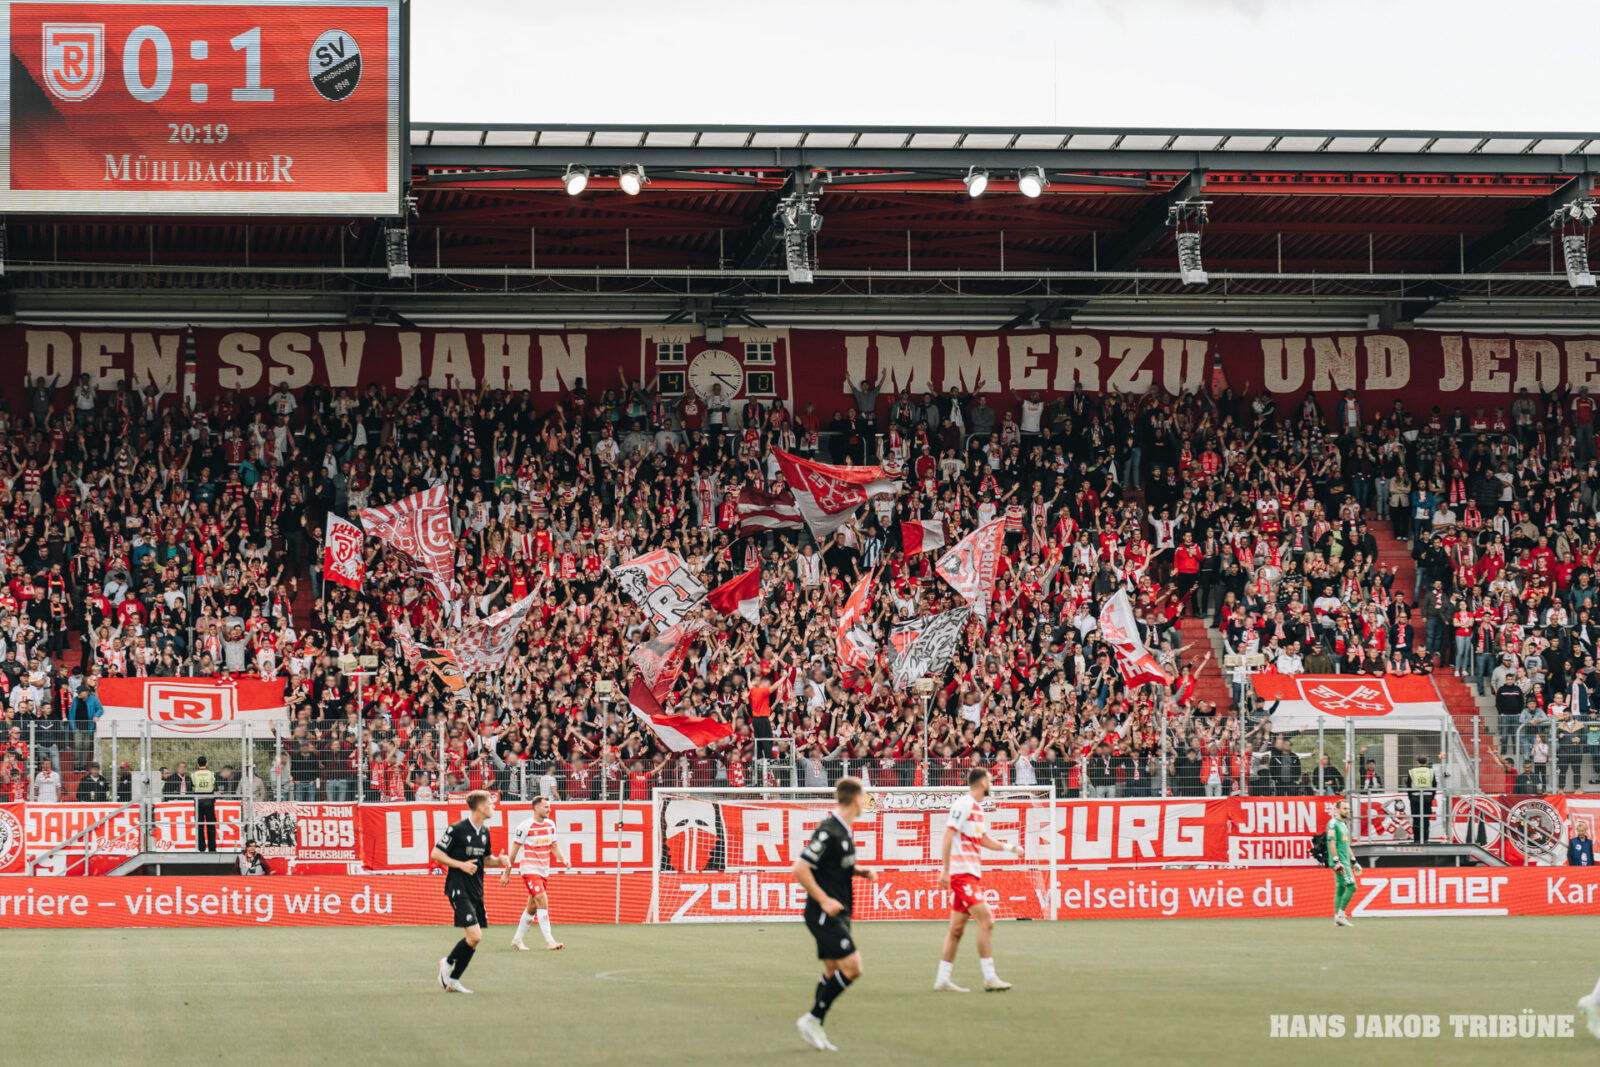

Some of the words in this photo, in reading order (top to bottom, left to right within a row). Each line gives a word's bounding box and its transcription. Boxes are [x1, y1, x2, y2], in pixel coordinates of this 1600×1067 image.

[315, 36, 345, 67] SV
[167, 123, 229, 144] 20:19
[103, 154, 296, 182] MÜHLBACHER
[24, 330, 180, 394] DEN
[218, 330, 366, 390] SSV
[395, 331, 588, 393] JAHN
[843, 334, 1208, 396] IMMERZU
[1261, 335, 1411, 393] UND
[1439, 335, 1600, 394] JEDE
[297, 806, 318, 817] SSV
[322, 806, 353, 818] JAHN
[1239, 801, 1317, 834] JAHN
[297, 819, 355, 848] 1889
[298, 849, 356, 860] REGENSBURG
[125, 886, 274, 922] vielseitig
[284, 886, 341, 914] wie
[351, 885, 393, 914] du
[670, 874, 808, 922] zollne
[873, 882, 1000, 910] Karrie
[1188, 880, 1244, 907] wie
[1253, 879, 1294, 907] du
[1351, 869, 1509, 917] zollner
